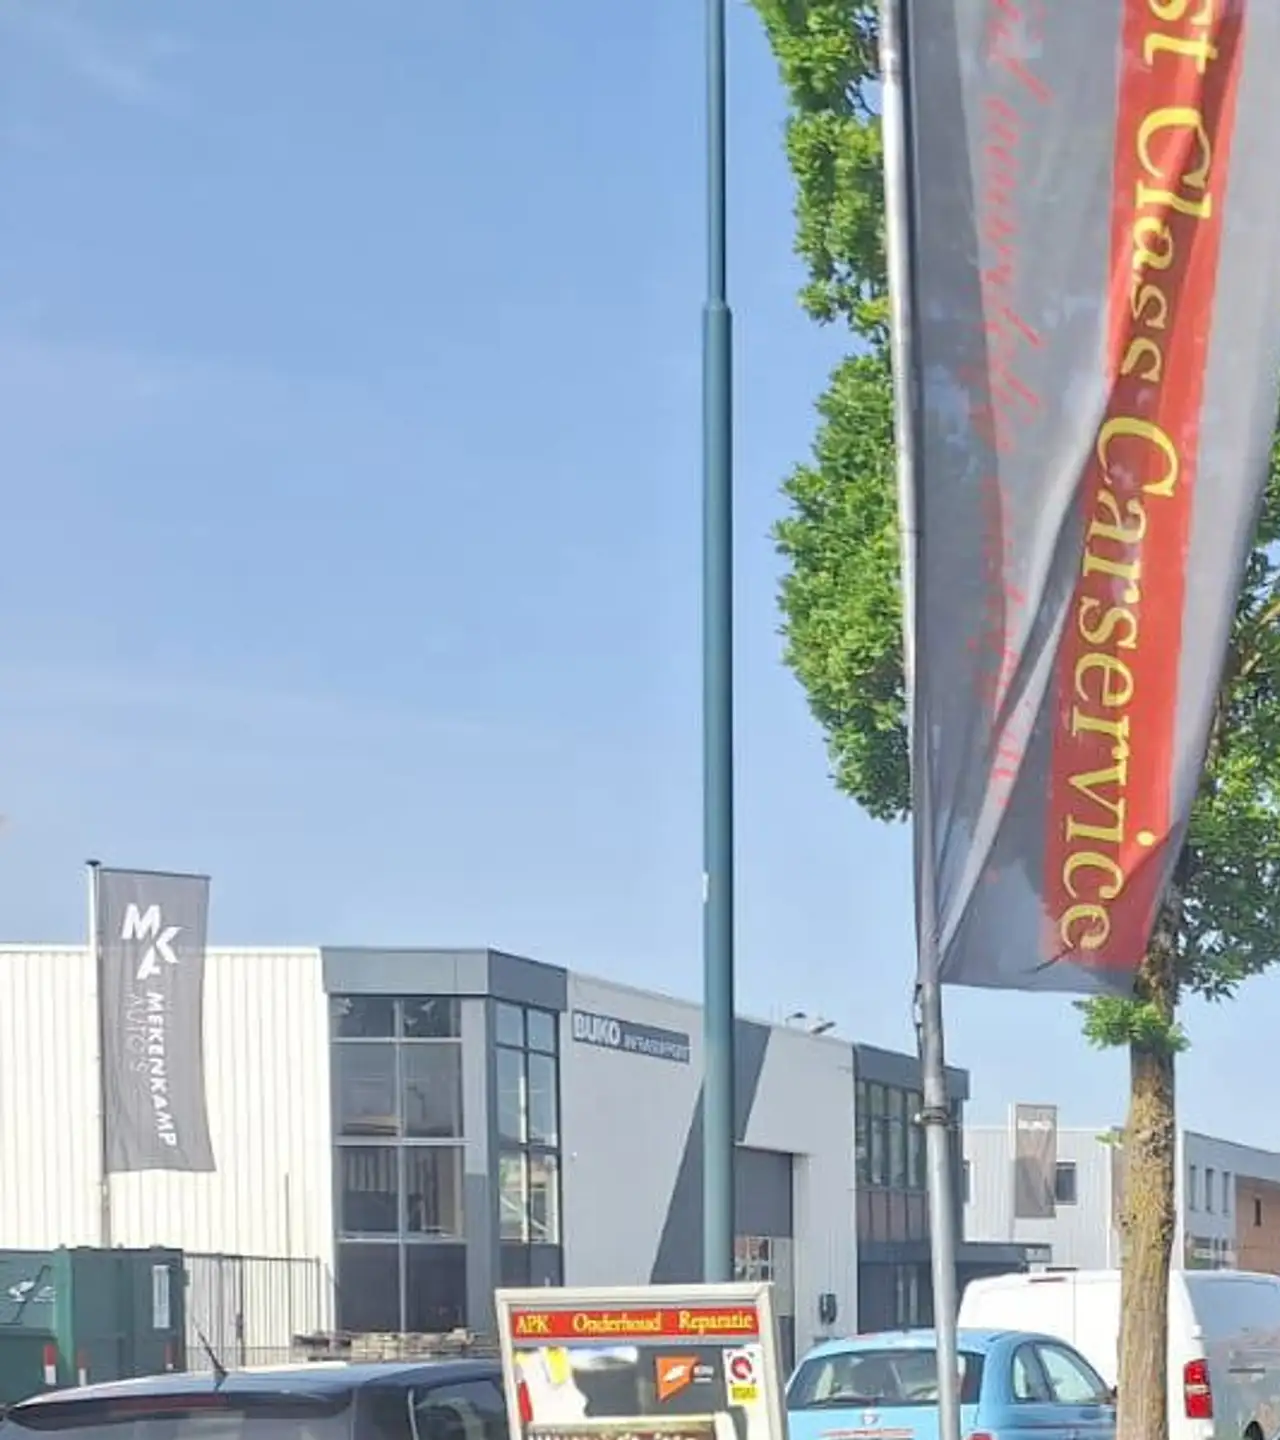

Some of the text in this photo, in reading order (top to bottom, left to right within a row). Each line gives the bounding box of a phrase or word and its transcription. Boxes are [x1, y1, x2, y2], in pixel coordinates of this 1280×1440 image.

[1122, 107, 1213, 383] Class
[1061, 417, 1179, 952] Carservice
[147, 991, 177, 1147] MEKENKAMP
[516, 1309, 753, 1335] APK Onderhoud Reparatie
